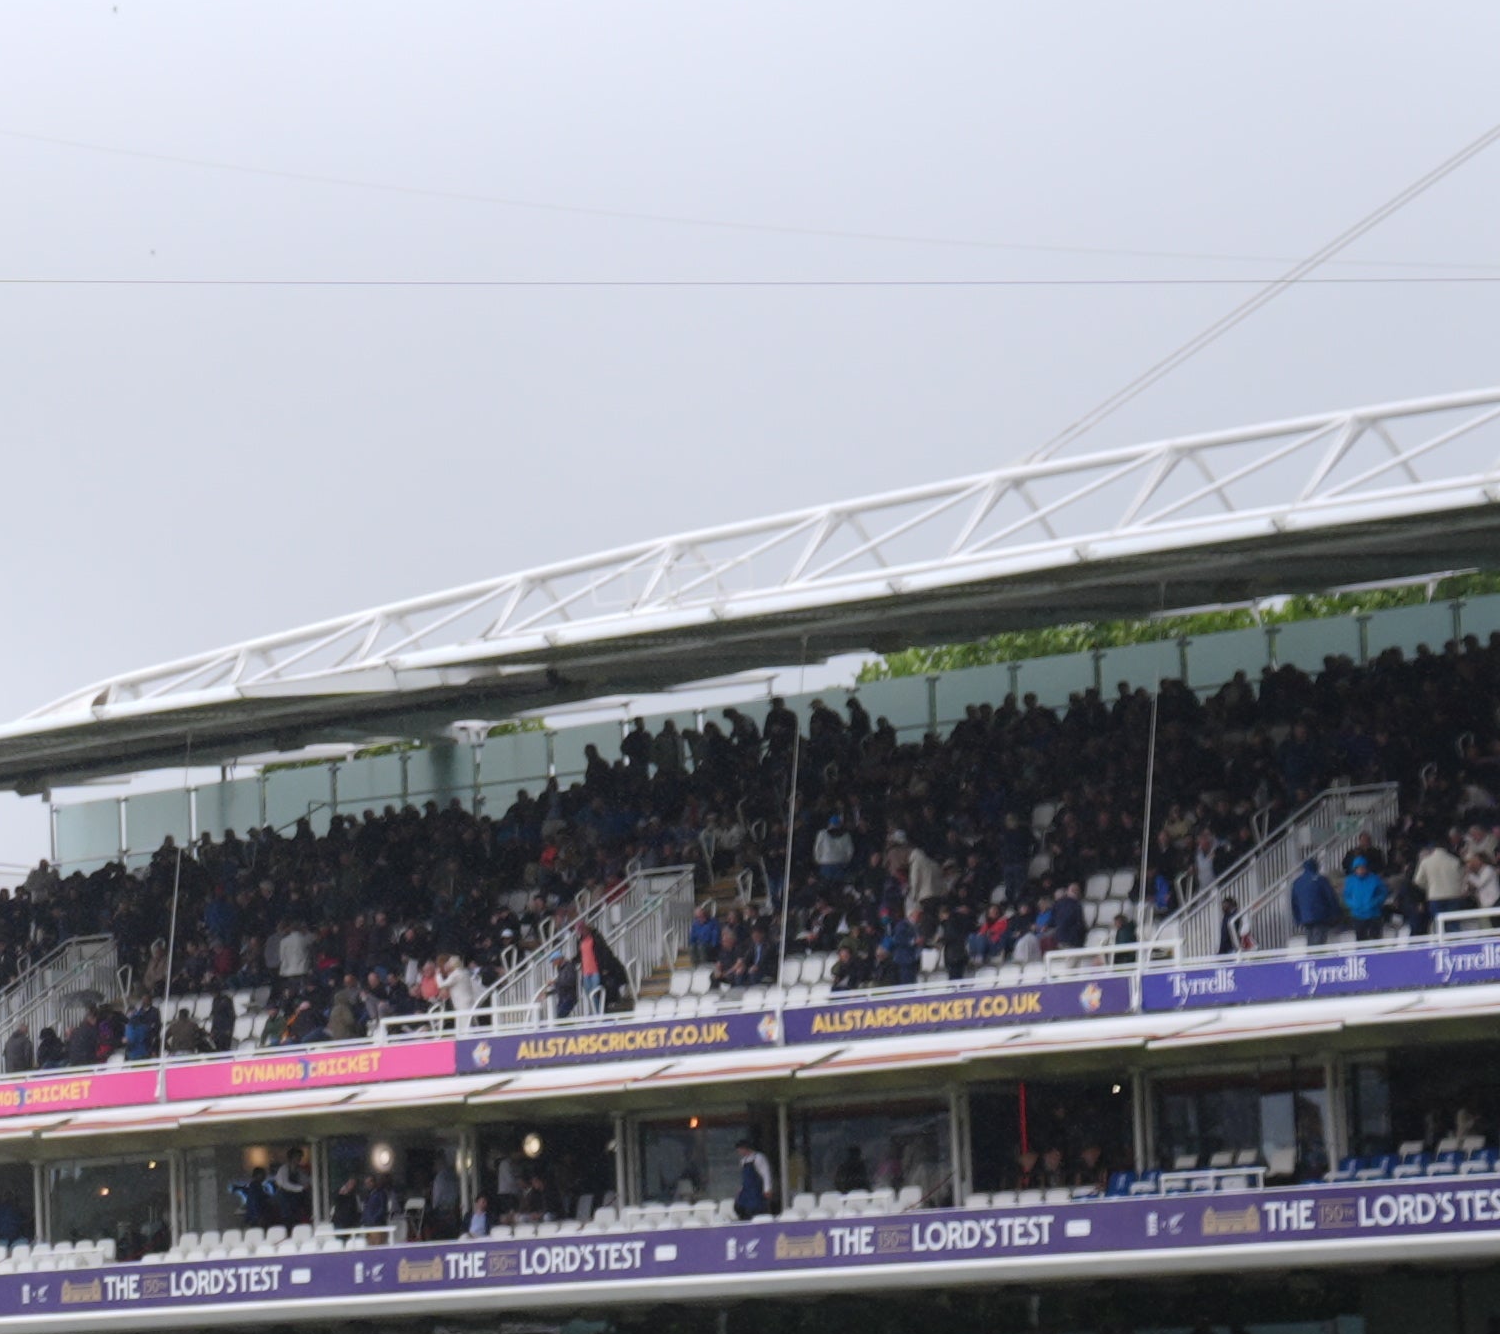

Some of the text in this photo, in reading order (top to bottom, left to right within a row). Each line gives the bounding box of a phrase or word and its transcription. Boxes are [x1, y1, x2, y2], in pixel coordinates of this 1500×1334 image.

[810, 992, 1042, 1034] ALLSTARSCRICKET.CO.UK
[516, 1022, 728, 1061] ALLSTARSCRICKET.CO.UK
[307, 1051, 382, 1077] CRICKET
[24, 1080, 92, 1102] CRICKET
[1263, 1198, 1316, 1232] THE
[1357, 1191, 1456, 1227] LORD'S
[829, 1225, 875, 1257] THE
[911, 1219, 997, 1252] LORD'S
[998, 1214, 1055, 1247] TEST
[446, 1251, 487, 1280] THE
[519, 1244, 595, 1275] LORD'S
[596, 1240, 646, 1269] TEST
[104, 1274, 140, 1300] THE
[170, 1268, 236, 1297] LORD'S
[237, 1264, 283, 1291] TEST
